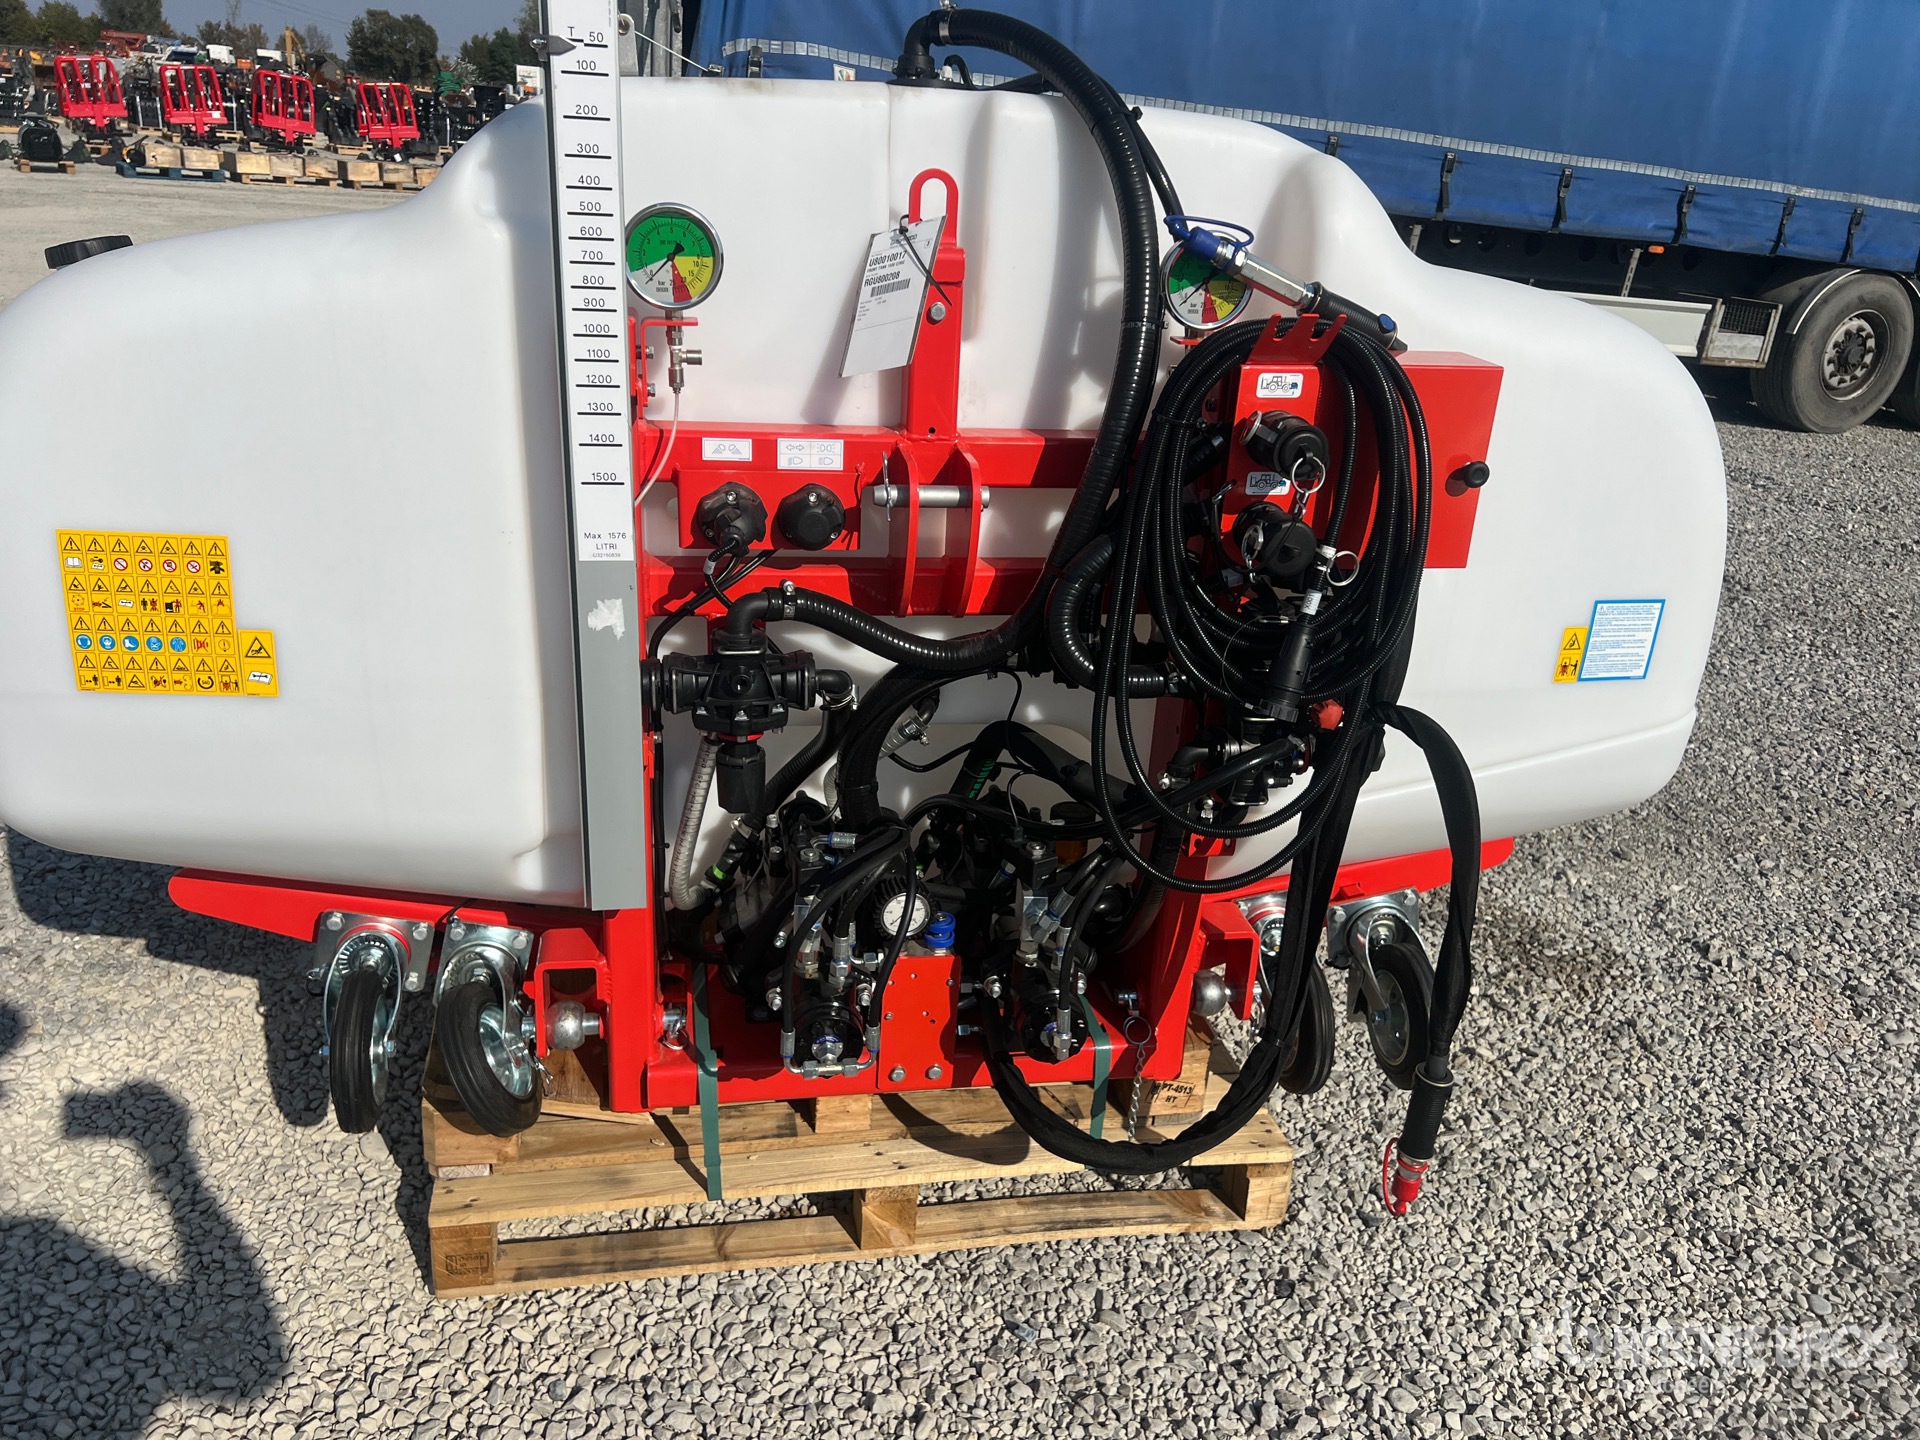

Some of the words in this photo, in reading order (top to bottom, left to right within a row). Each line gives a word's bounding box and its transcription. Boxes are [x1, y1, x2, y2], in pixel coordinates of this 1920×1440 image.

[567, 26, 575, 37] T
[589, 32, 604, 43] 50
[576, 60, 597, 71] 100
[575, 104, 598, 116] 200
[576, 143, 600, 154] 300
[578, 175, 601, 186] 400
[579, 201, 602, 212] 500
[580, 226, 603, 237] 600
[581, 250, 604, 261] 700
[582, 275, 605, 286] 800
[583, 298, 606, 308] 900
[583, 324, 611, 334] 1000
[587, 349, 611, 359] 1100
[586, 374, 613, 384] 1200
[587, 402, 614, 412] 1300
[589, 433, 615, 443] 1400
[591, 472, 617, 482] 1500
[584, 532, 602, 540] Max
[608, 532, 627, 540] 1576
[595, 543, 618, 551] LITRI
[1162, 1083, 1193, 1095] PT-4513
[1165, 1095, 1177, 1103] HT
